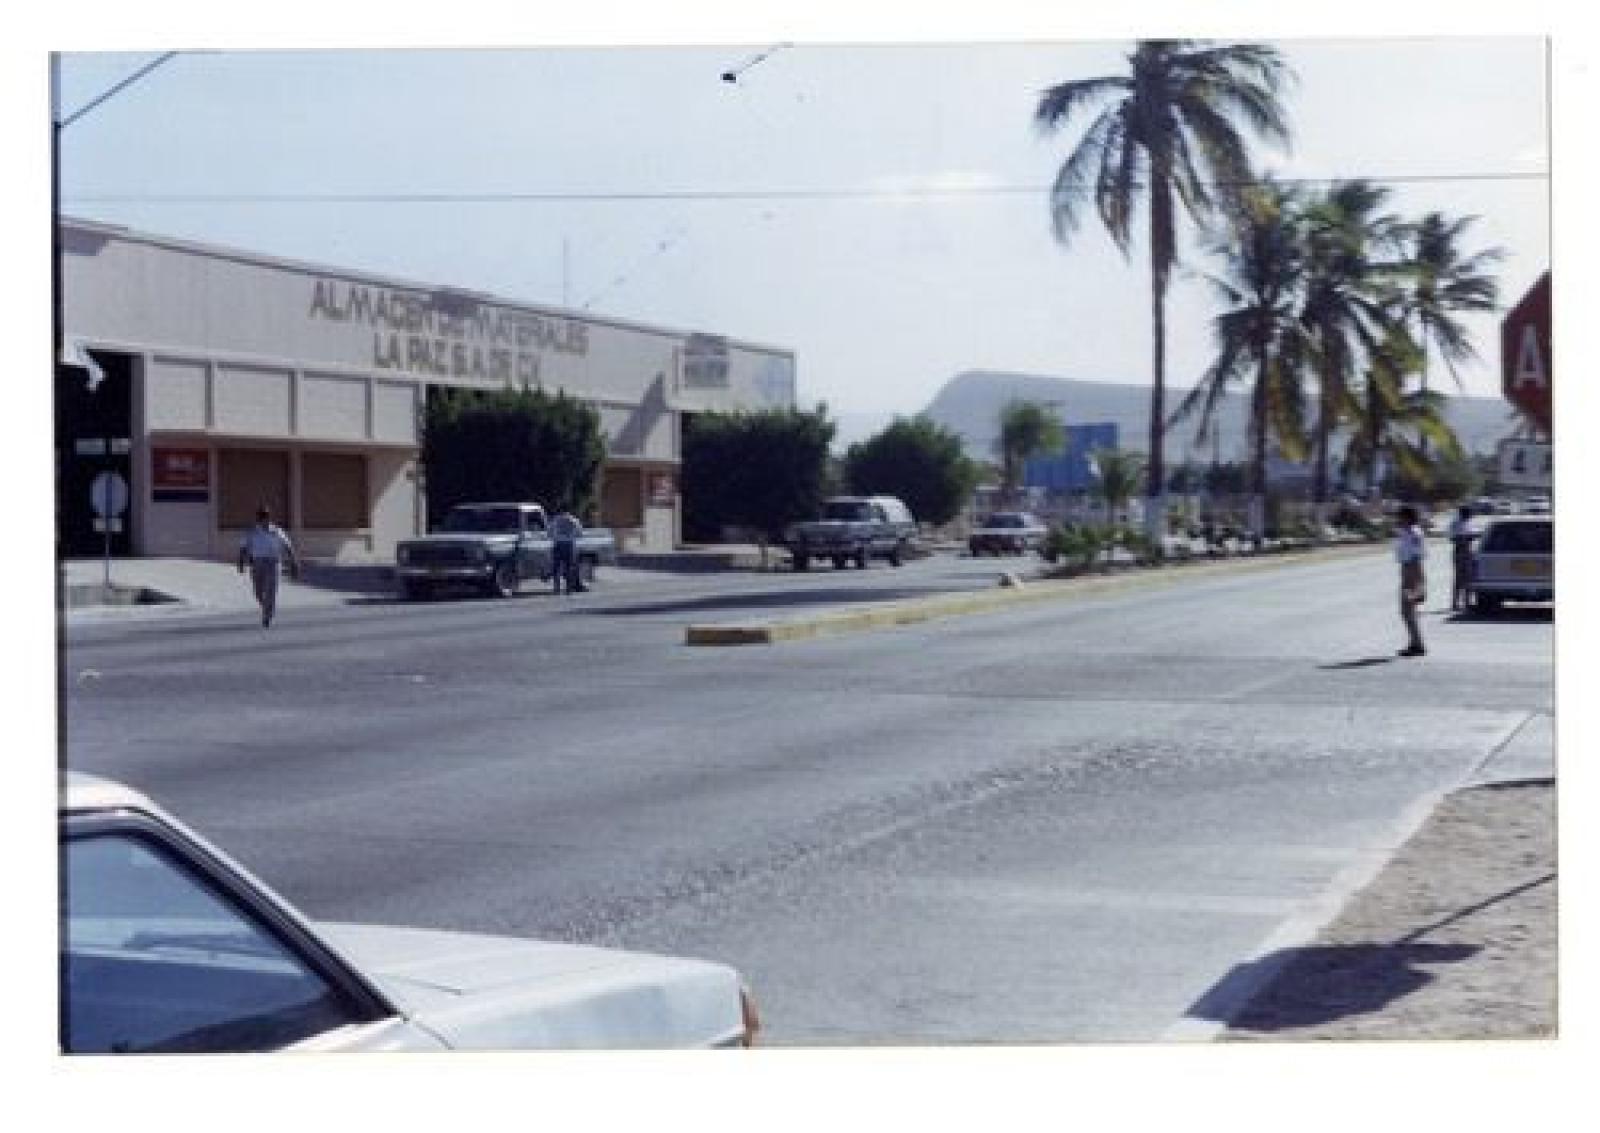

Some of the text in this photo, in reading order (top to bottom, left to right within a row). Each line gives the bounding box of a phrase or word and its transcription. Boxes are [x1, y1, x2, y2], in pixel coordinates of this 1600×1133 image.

[307, 280, 432, 331] ALMACEN
[467, 305, 589, 355] MATERIALES
[374, 332, 398, 368] LA
[406, 336, 448, 374] PAZ
